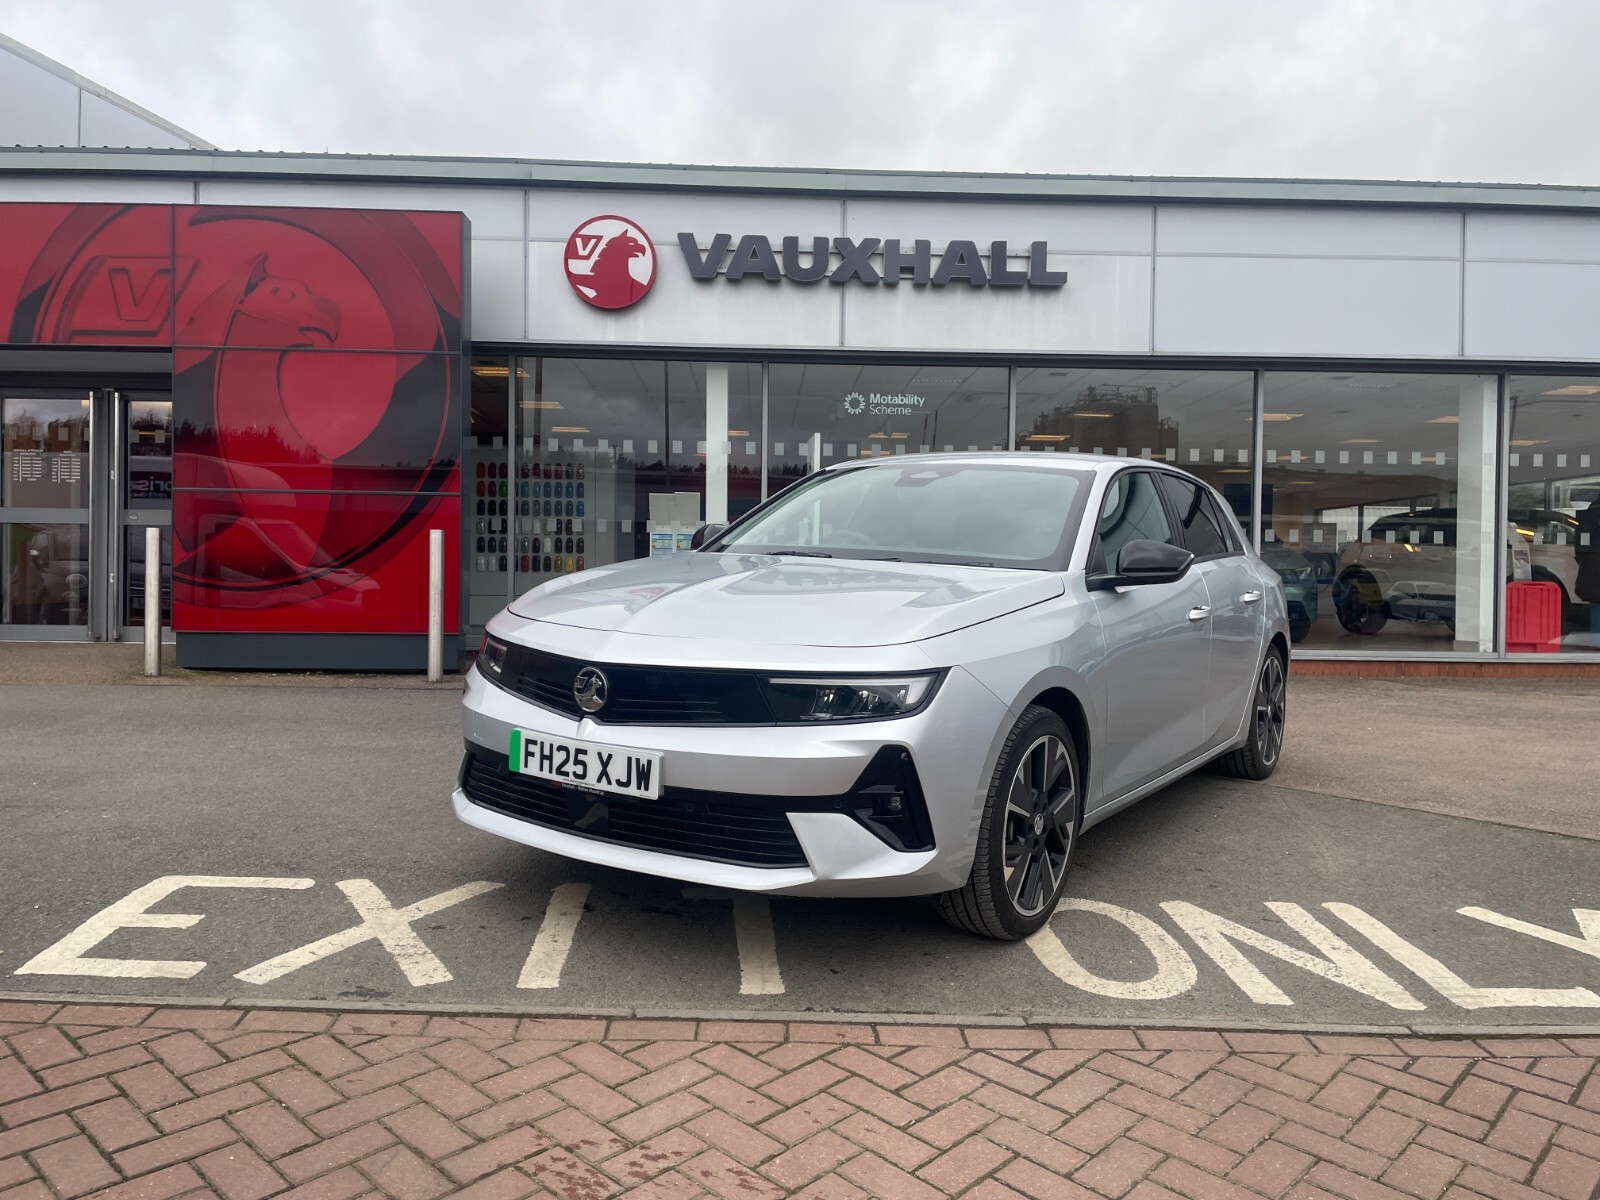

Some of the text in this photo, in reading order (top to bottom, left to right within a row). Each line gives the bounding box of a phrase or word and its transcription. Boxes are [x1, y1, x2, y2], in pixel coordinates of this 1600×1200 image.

[677, 232, 1068, 288] VAUXHALL
[869, 392, 925, 408] Motability
[869, 403, 912, 416] Scheme
[523, 737, 653, 792] FH25 XJW
[14, 875, 786, 996] EXIT
